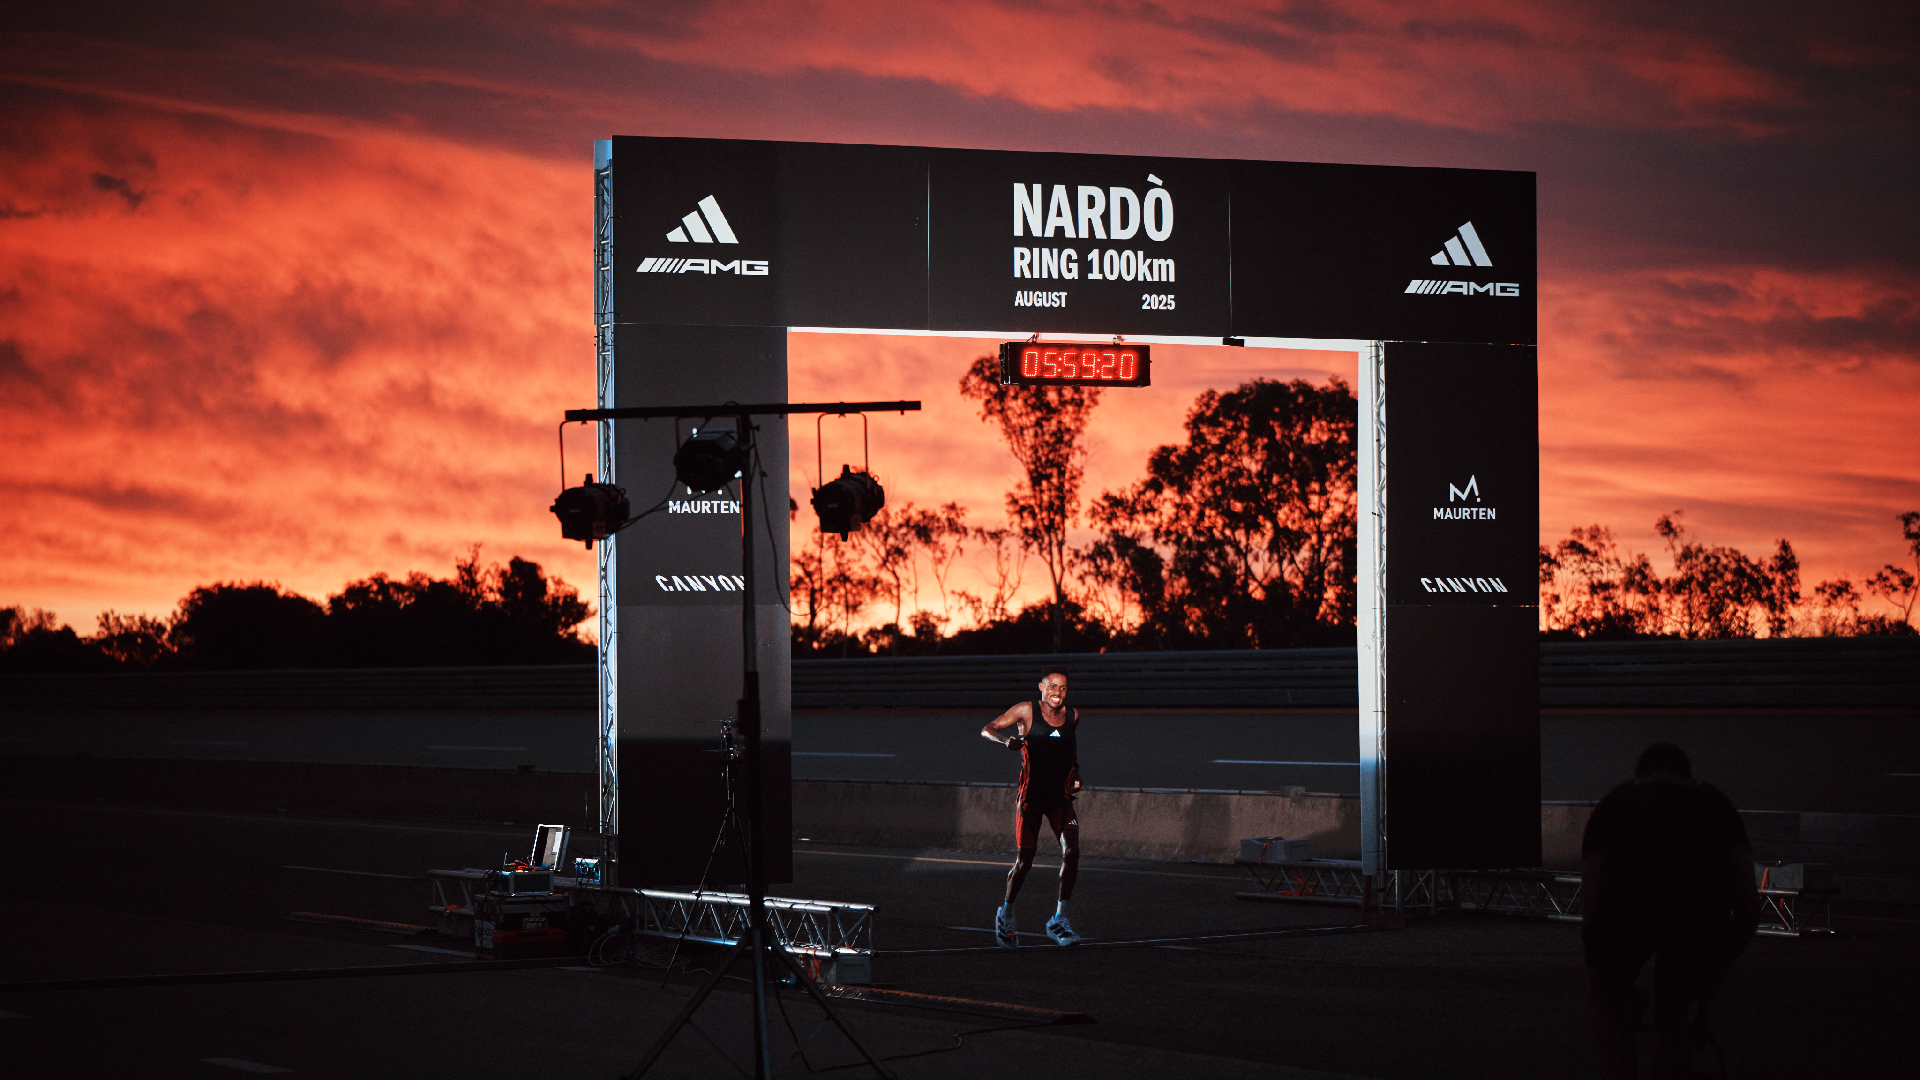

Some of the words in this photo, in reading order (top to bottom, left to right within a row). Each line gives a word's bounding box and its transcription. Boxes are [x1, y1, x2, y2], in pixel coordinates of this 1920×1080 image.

[1013, 173, 1174, 242] NARDÒ
[1013, 246, 1079, 280] RING
[1087, 248, 1176, 283] 100km
[1014, 290, 1068, 308] AUGUST
[1141, 293, 1176, 311] 2025
[1023, 350, 1135, 380] 05:59:20
[667, 500, 741, 514] MAURTEN
[1433, 507, 1496, 520] MAURTEN
[1420, 577, 1509, 593] CANYON
